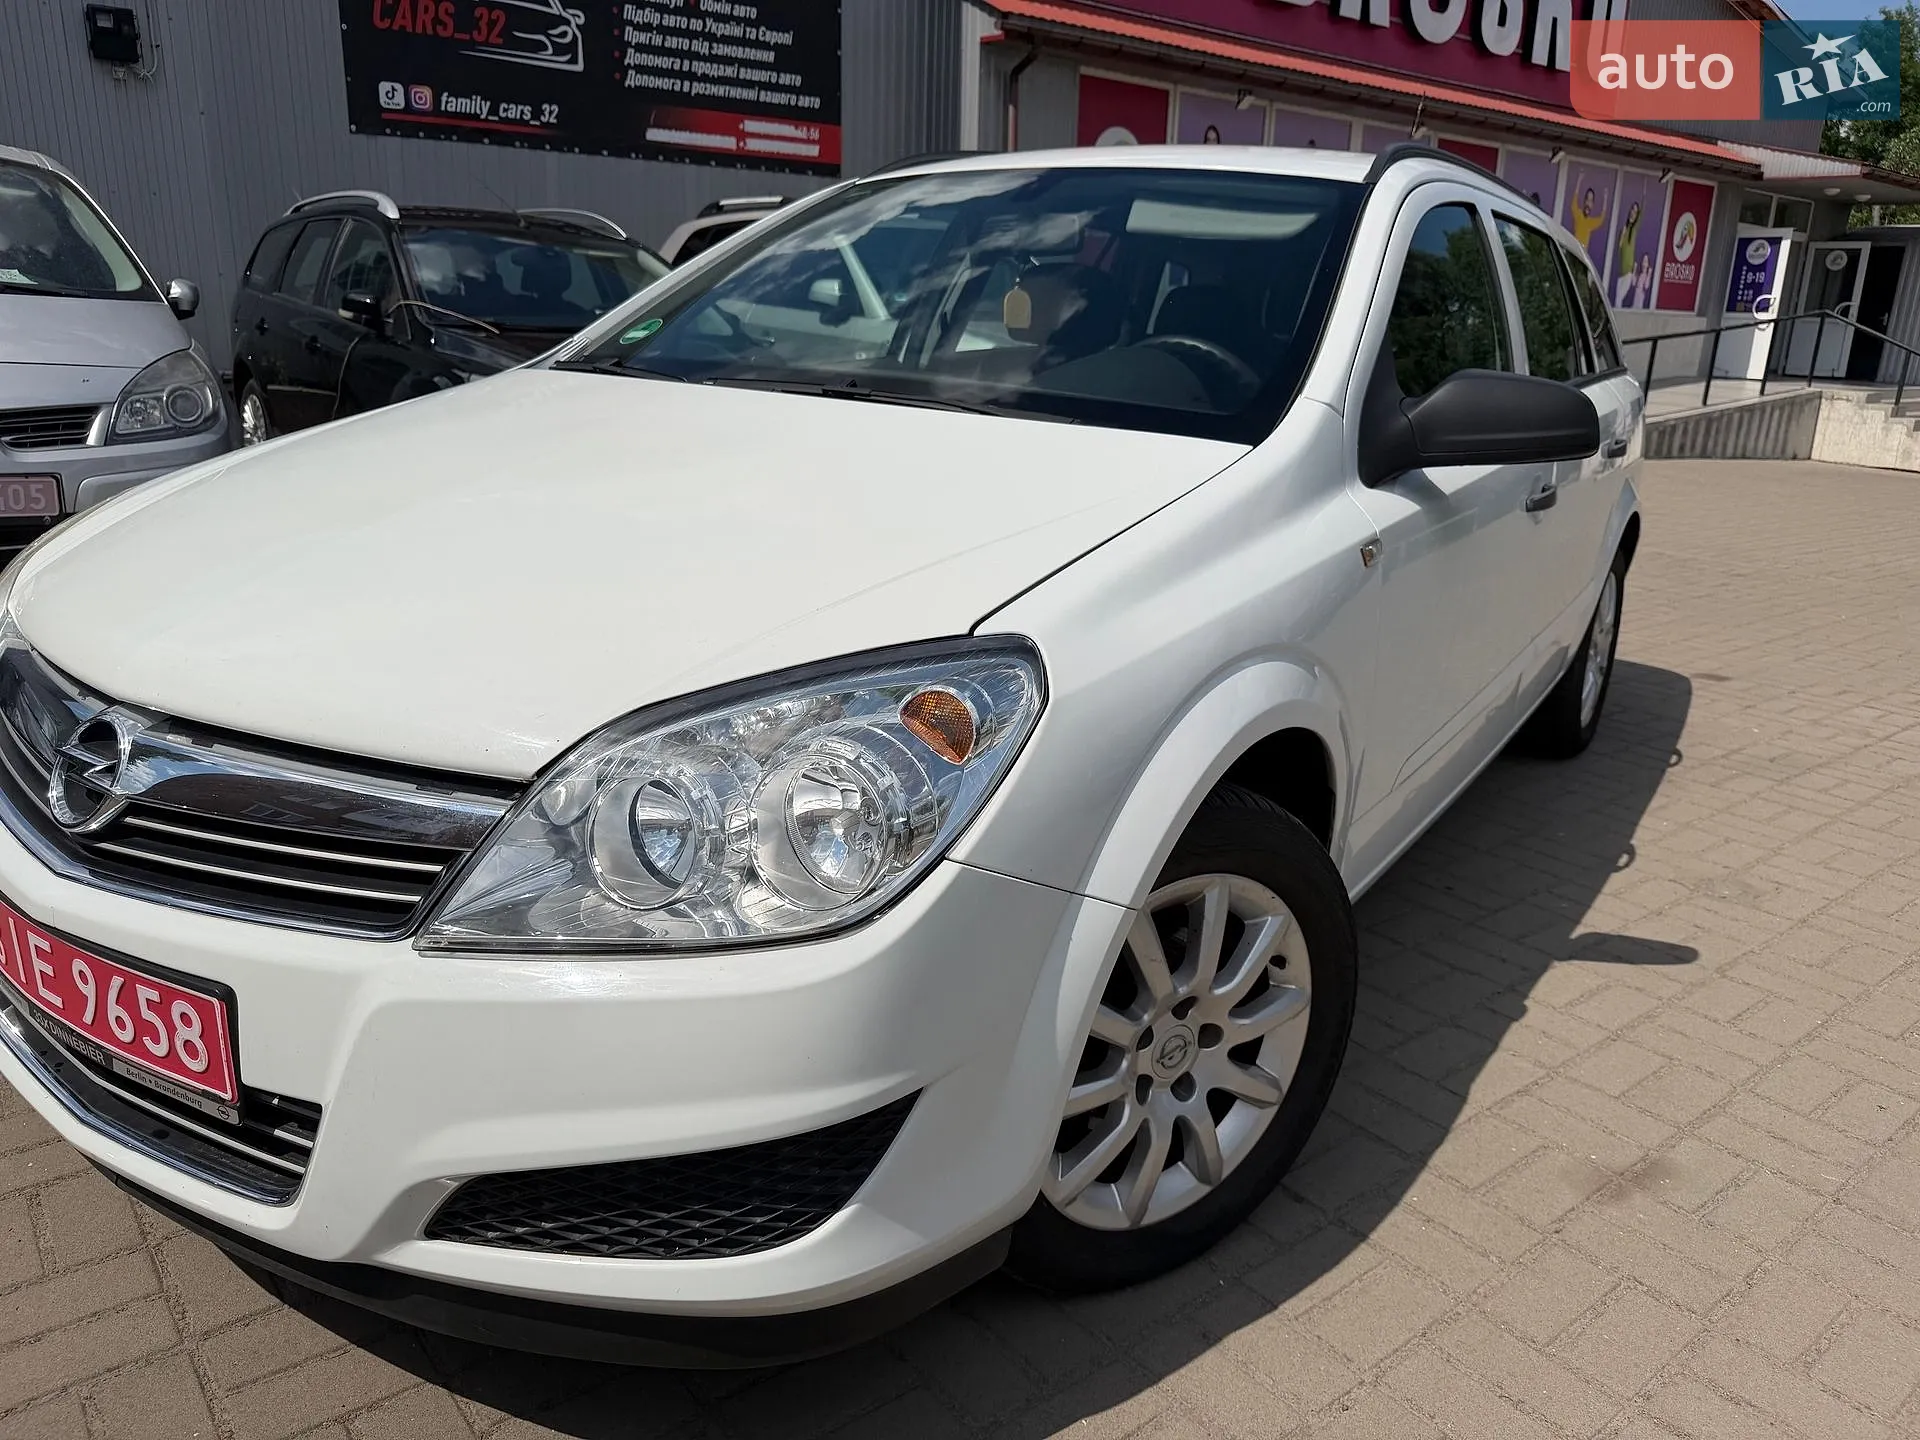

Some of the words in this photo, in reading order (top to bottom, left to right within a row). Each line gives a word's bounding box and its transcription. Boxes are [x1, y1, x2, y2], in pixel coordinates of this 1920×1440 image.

[371, 0, 506, 44] CARS_32
[623, 4, 661, 26] Підбір
[662, 14, 688, 29] авто
[689, 17, 702, 32] по
[704, 18, 744, 39] Україні
[745, 24, 757, 39] та
[758, 27, 793, 46] Європі
[732, 4, 757, 19] авто
[624, 26, 662, 46] Пригін
[664, 34, 689, 50] авто
[691, 38, 710, 57] під
[711, 43, 775, 63] замовлення
[624, 48, 681, 71] Допомога
[682, 60, 689, 71] в
[691, 62, 737, 79] продажі
[739, 67, 778, 84] вашого
[779, 74, 802, 87] авто
[440, 91, 559, 125] family_cars_32
[625, 69, 682, 92] Допомога
[683, 80, 690, 92] в
[759, 89, 797, 107] вашого
[798, 97, 821, 109] авто
[71, 958, 209, 1073] 9658
[126, 1067, 148, 1085] Berlin
[153, 1079, 203, 1109] Brandenburg
